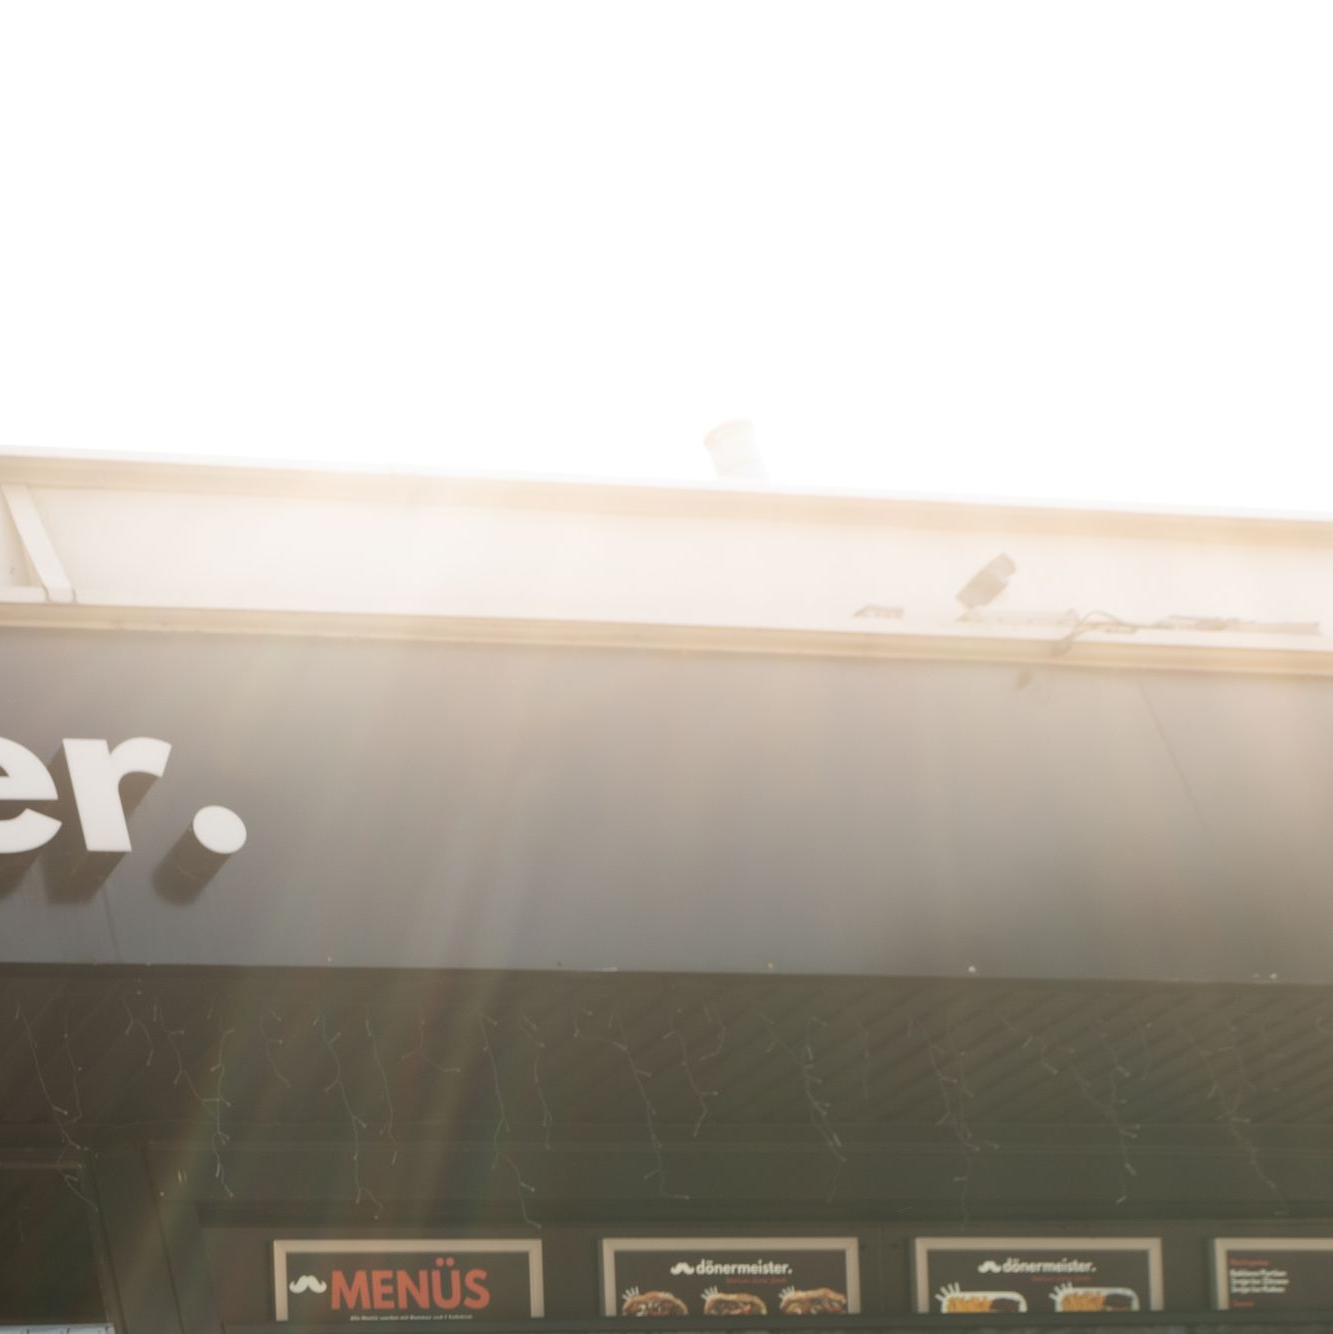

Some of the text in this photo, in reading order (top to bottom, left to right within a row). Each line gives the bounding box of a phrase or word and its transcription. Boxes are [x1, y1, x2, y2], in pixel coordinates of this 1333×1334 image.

[696, 1258, 792, 1275] dönermeister.
[1002, 1257, 1097, 1273] dönermeister.
[331, 1257, 491, 1310] MENÜS
